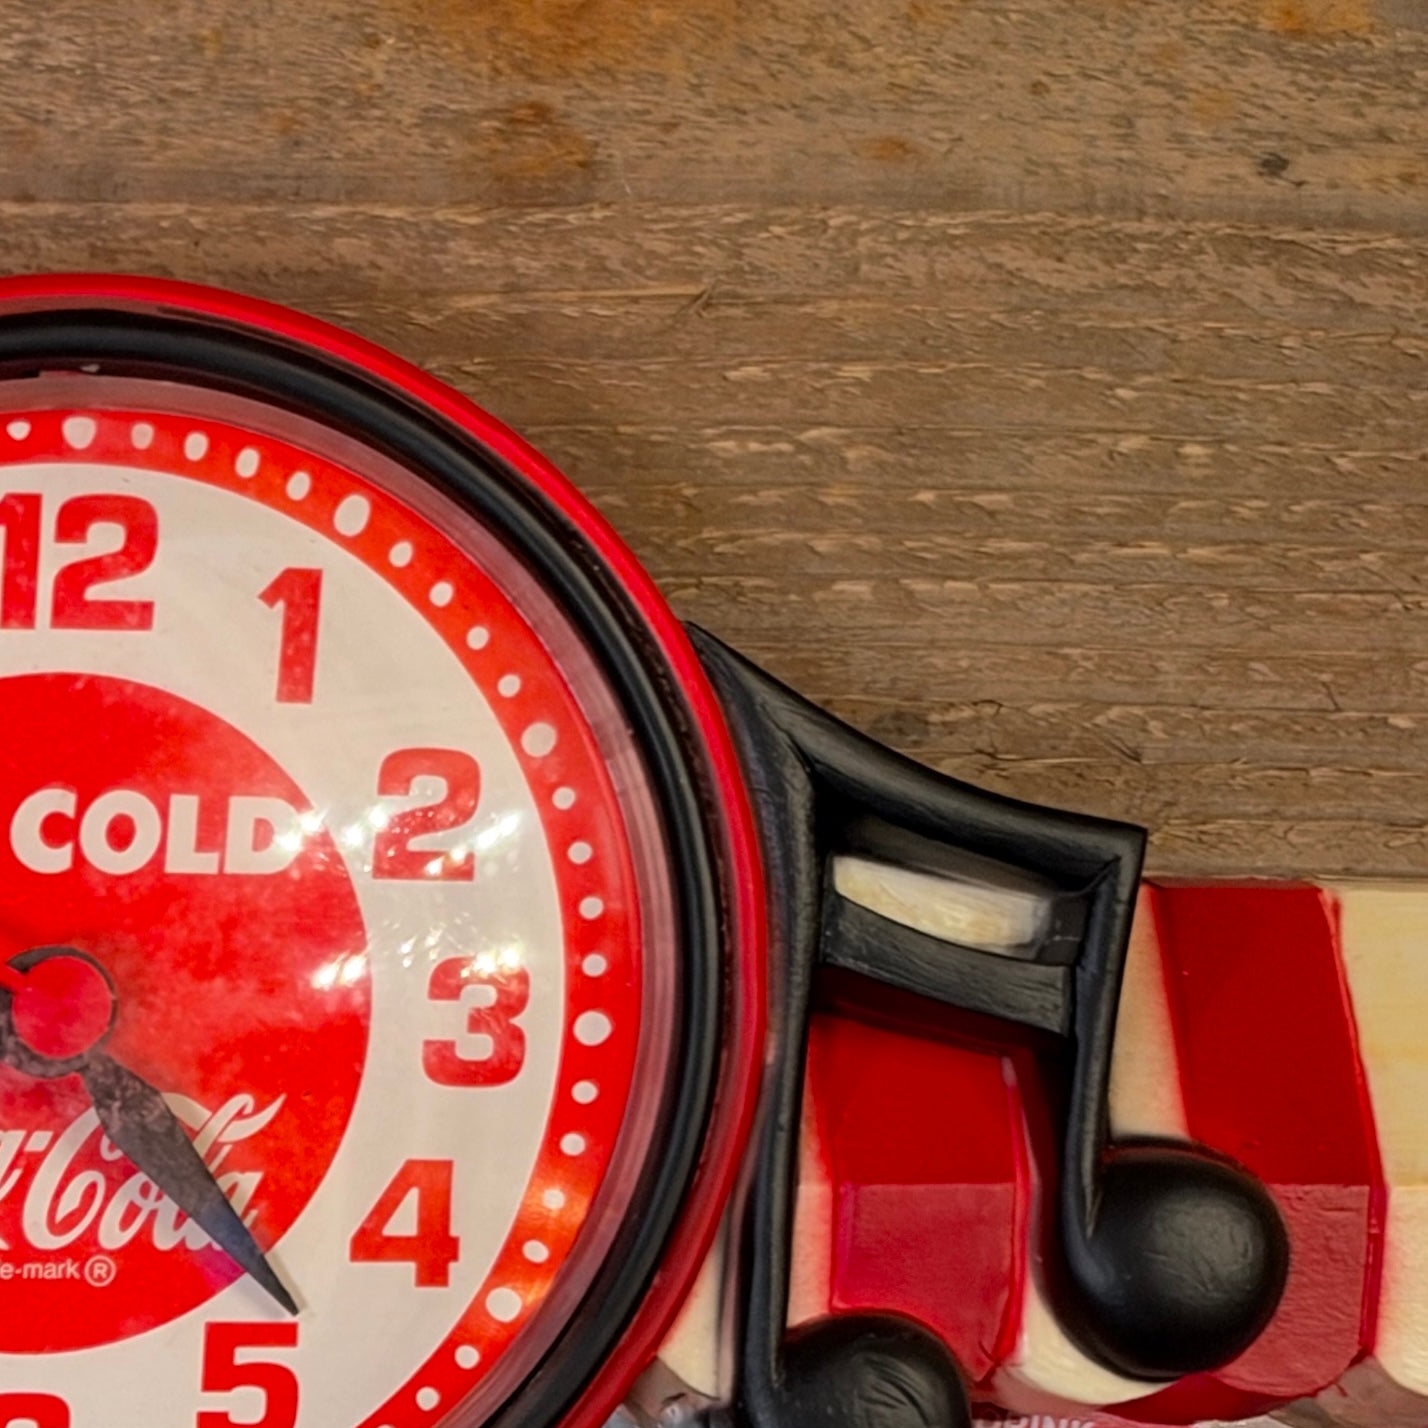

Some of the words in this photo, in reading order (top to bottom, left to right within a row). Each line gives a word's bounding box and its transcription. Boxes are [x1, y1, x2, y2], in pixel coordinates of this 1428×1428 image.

[256, 566, 325, 705] 1
[11, 788, 316, 876] COLD
[370, 747, 482, 883] 2
[420, 955, 530, 1088] 3
[348, 1158, 460, 1288] 4
